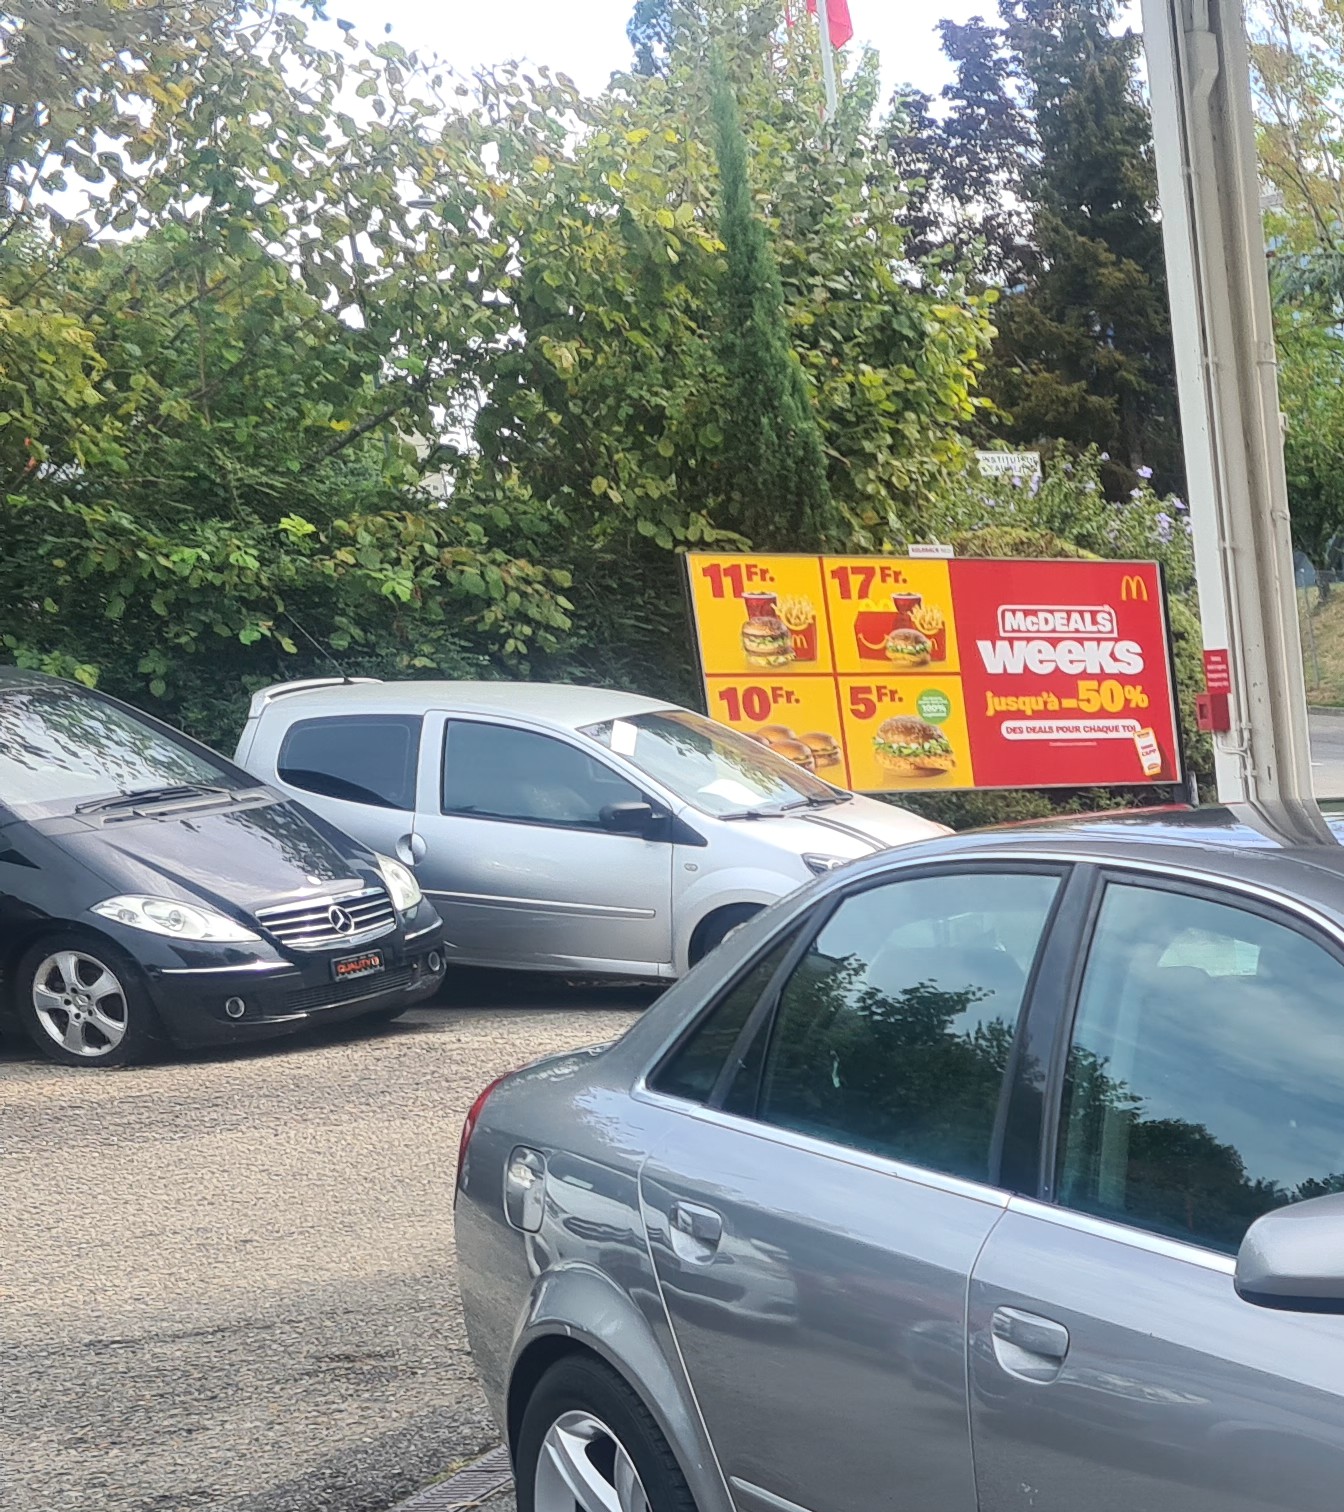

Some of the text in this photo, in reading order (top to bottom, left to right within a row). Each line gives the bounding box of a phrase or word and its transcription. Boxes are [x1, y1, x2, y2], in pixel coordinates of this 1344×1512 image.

[702, 563, 775, 598] 11 Fr.
[831, 566, 908, 600] 17 Fr.
[1004, 611, 1112, 632] McDEALS
[719, 686, 801, 722] 10 Fr.
[849, 685, 904, 720] 5 Fr.
[985, 679, 1149, 717] jusqu'à -50%
[1005, 726, 1024, 734] DES
[1026, 725, 1054, 734] DEALS
[1055, 725, 1082, 733] POUR
[1083, 725, 1120, 734] CHAQUE
